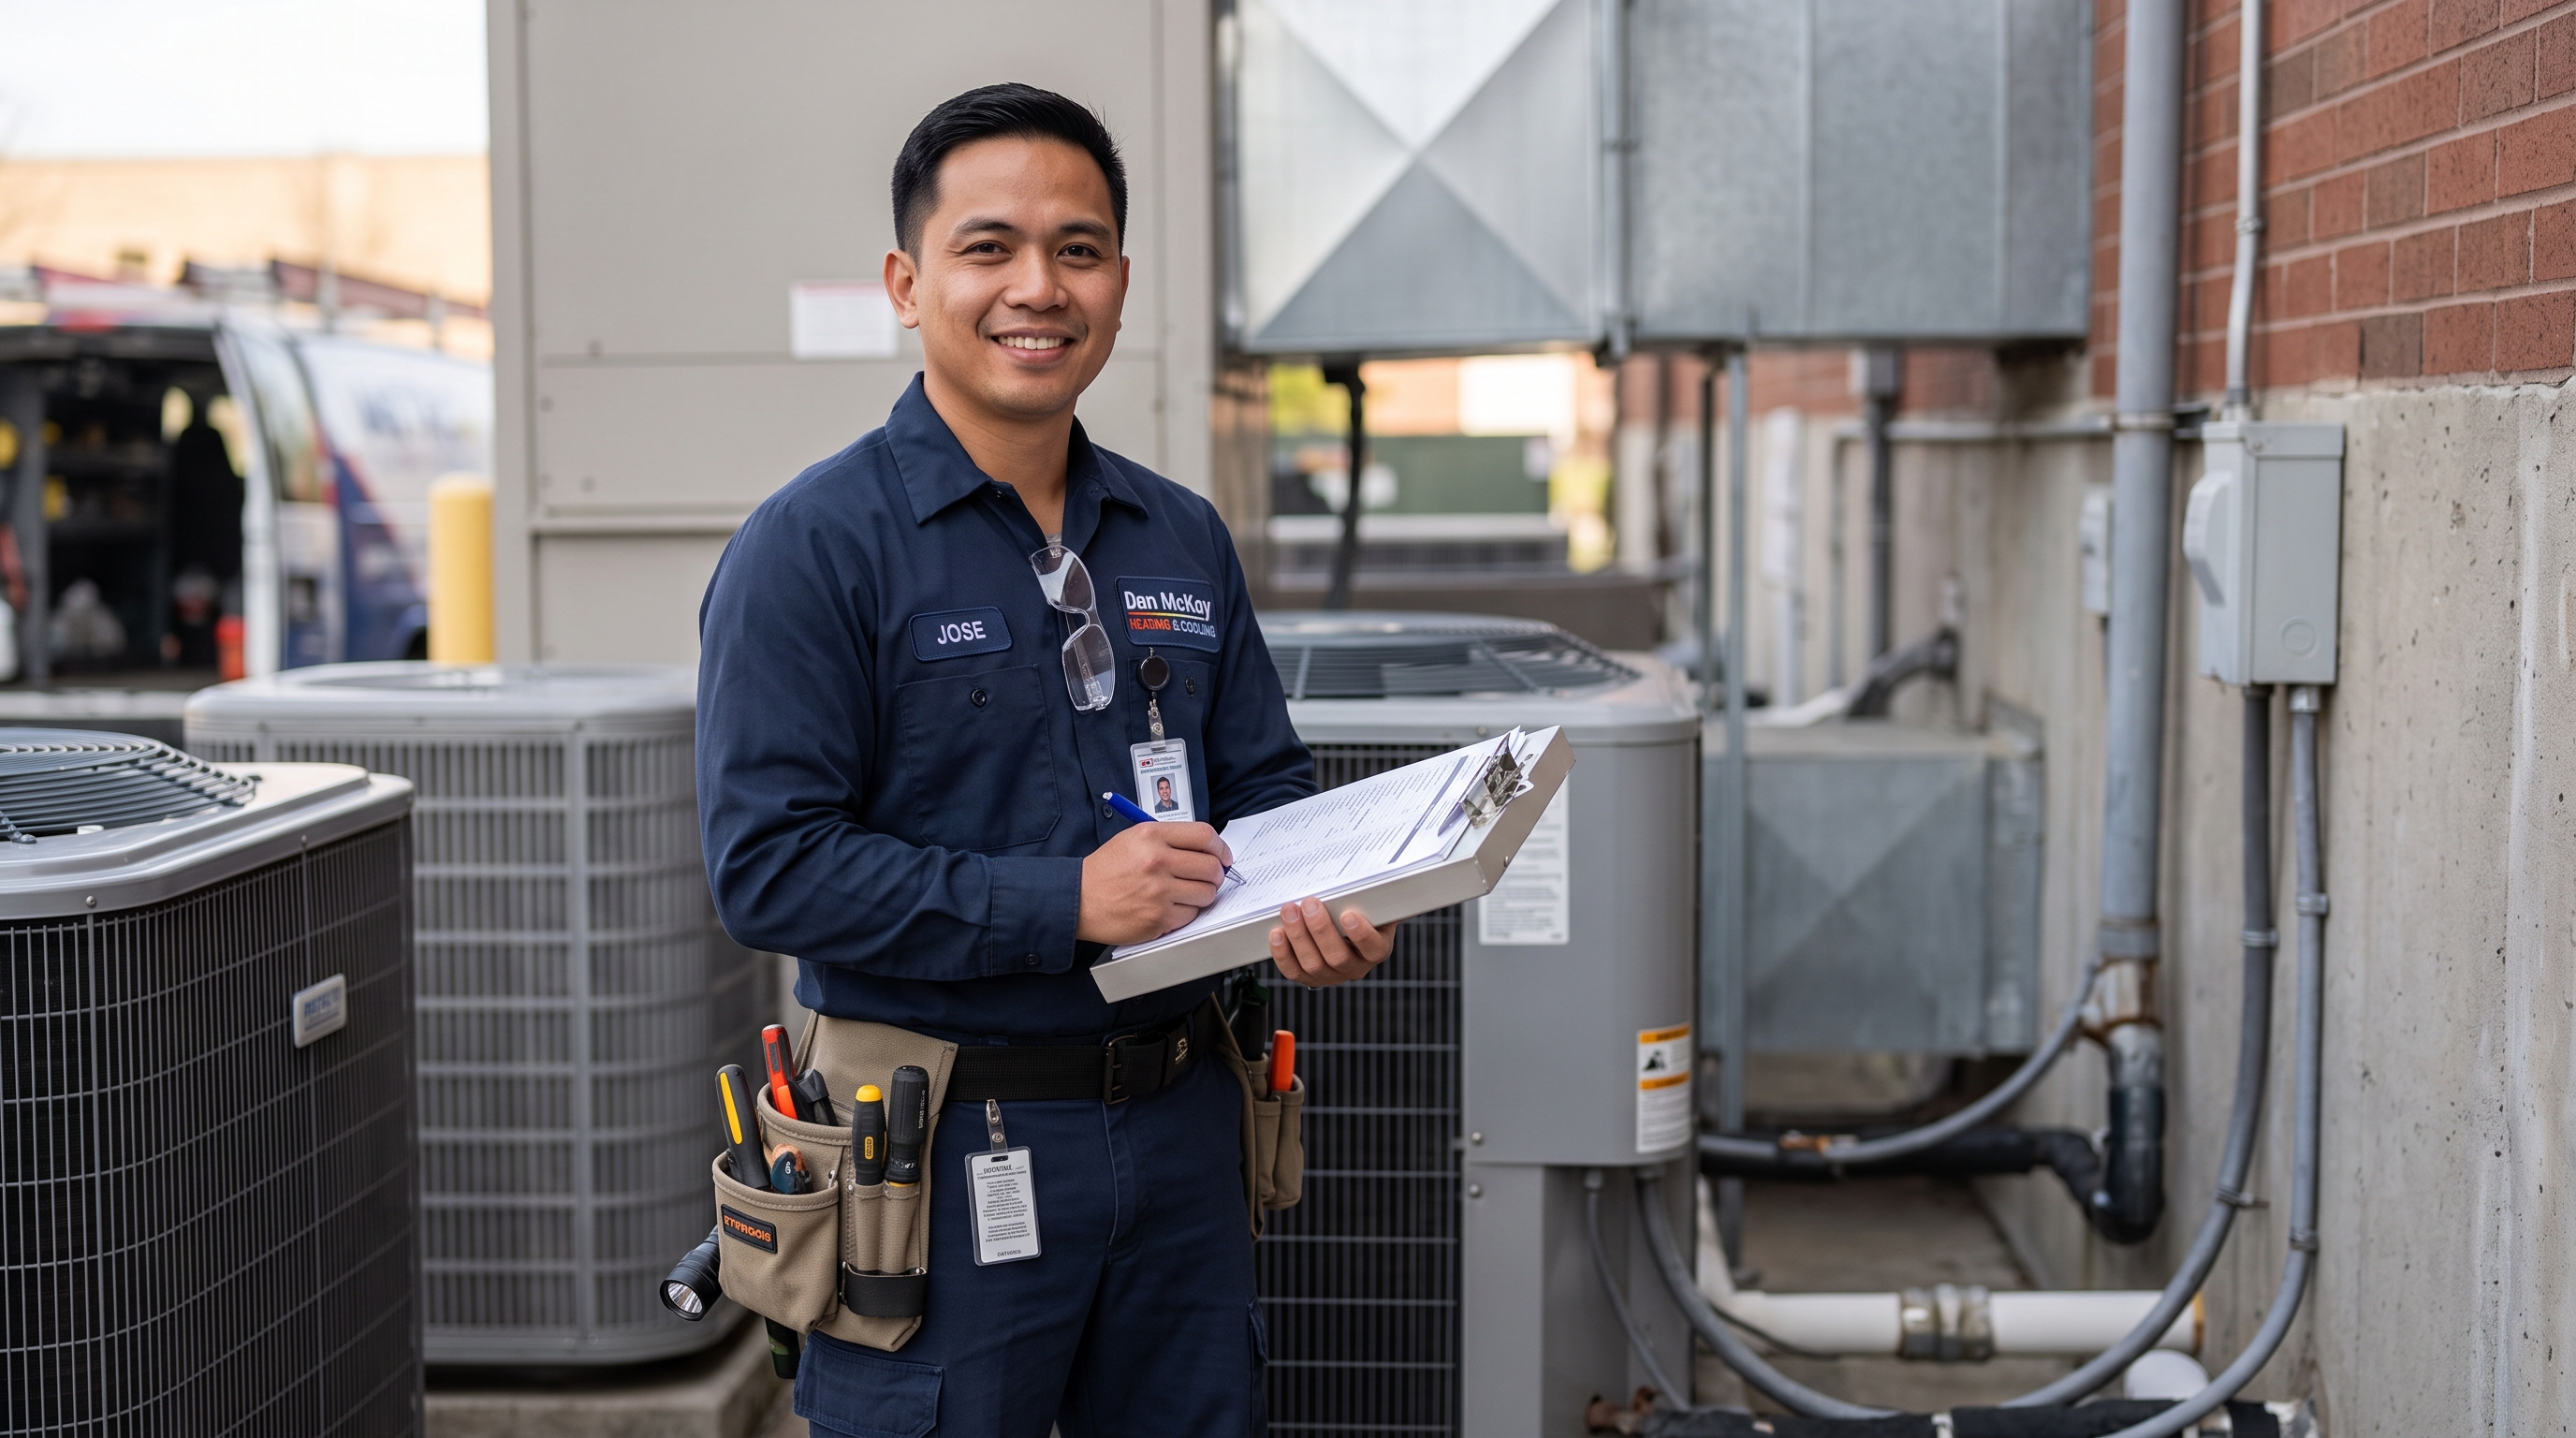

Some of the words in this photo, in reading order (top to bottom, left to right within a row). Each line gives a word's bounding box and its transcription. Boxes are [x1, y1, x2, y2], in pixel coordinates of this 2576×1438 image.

[1123, 591, 1159, 610] Dan
[1160, 592, 1211, 622] McKay
[937, 621, 987, 645] JOSE
[1172, 619, 1180, 631] &
